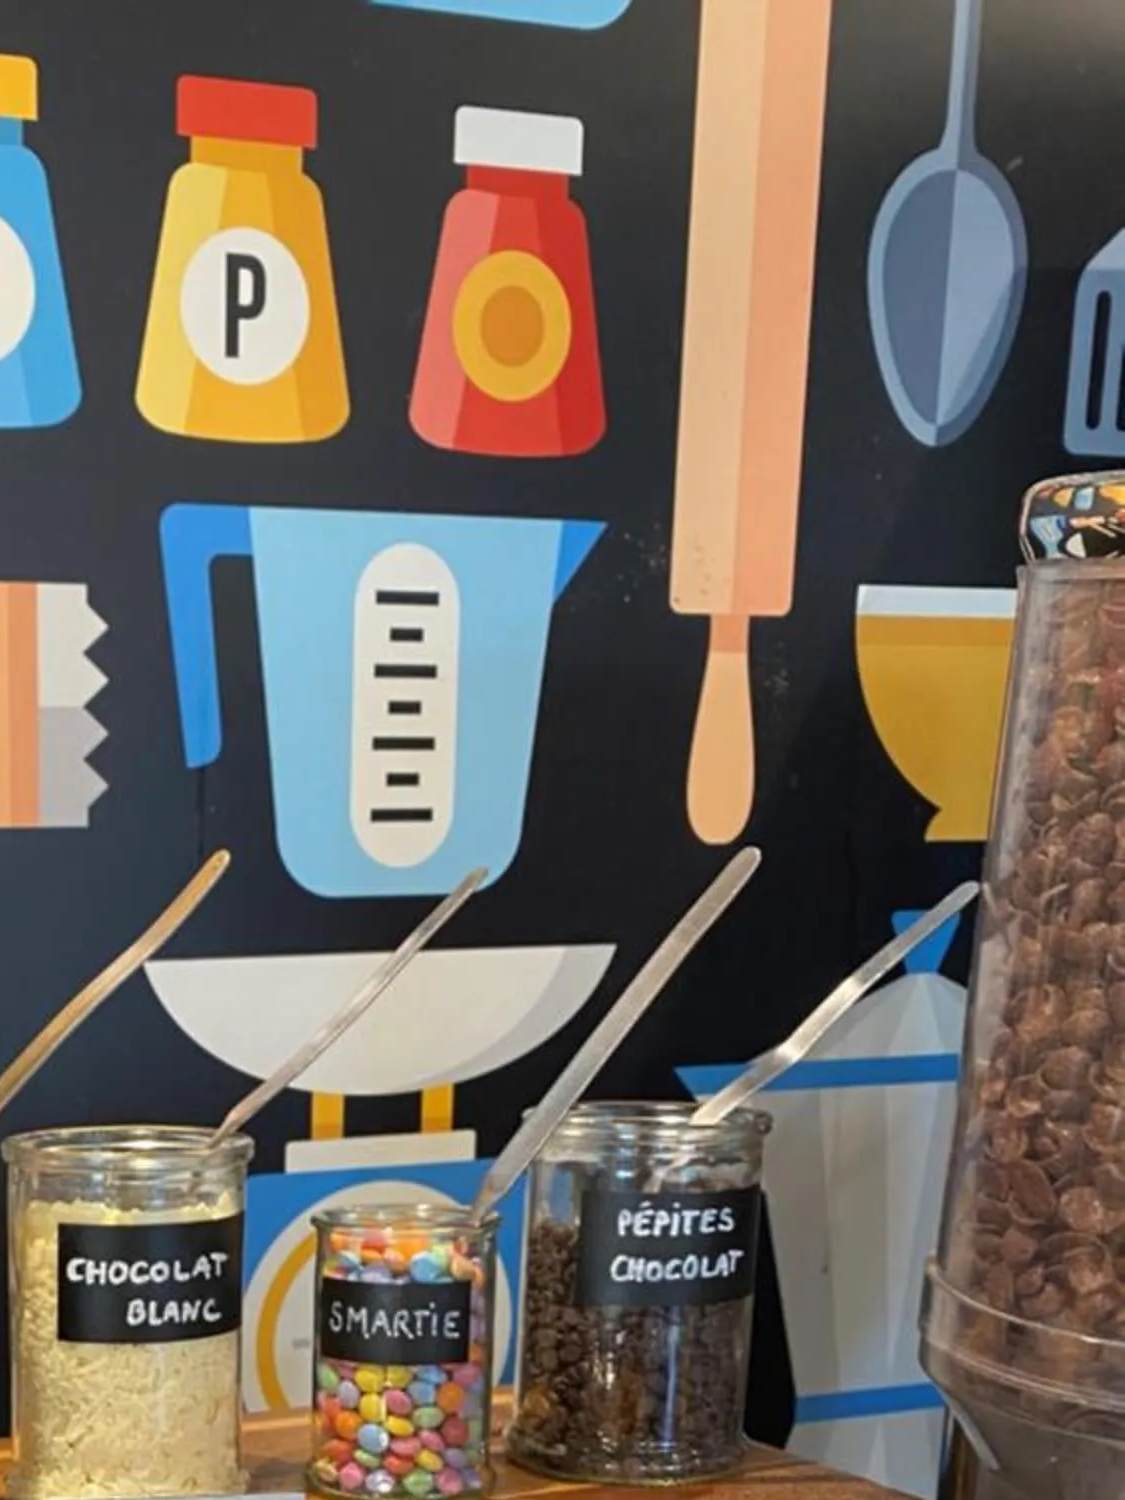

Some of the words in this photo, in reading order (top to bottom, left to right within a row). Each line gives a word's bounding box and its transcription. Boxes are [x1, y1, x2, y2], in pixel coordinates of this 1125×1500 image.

[224, 252, 267, 359] P
[65, 1252, 229, 1287] CHOCOLAT
[609, 1249, 745, 1284] CHOCOLAT
[125, 1298, 222, 1328] BLANC
